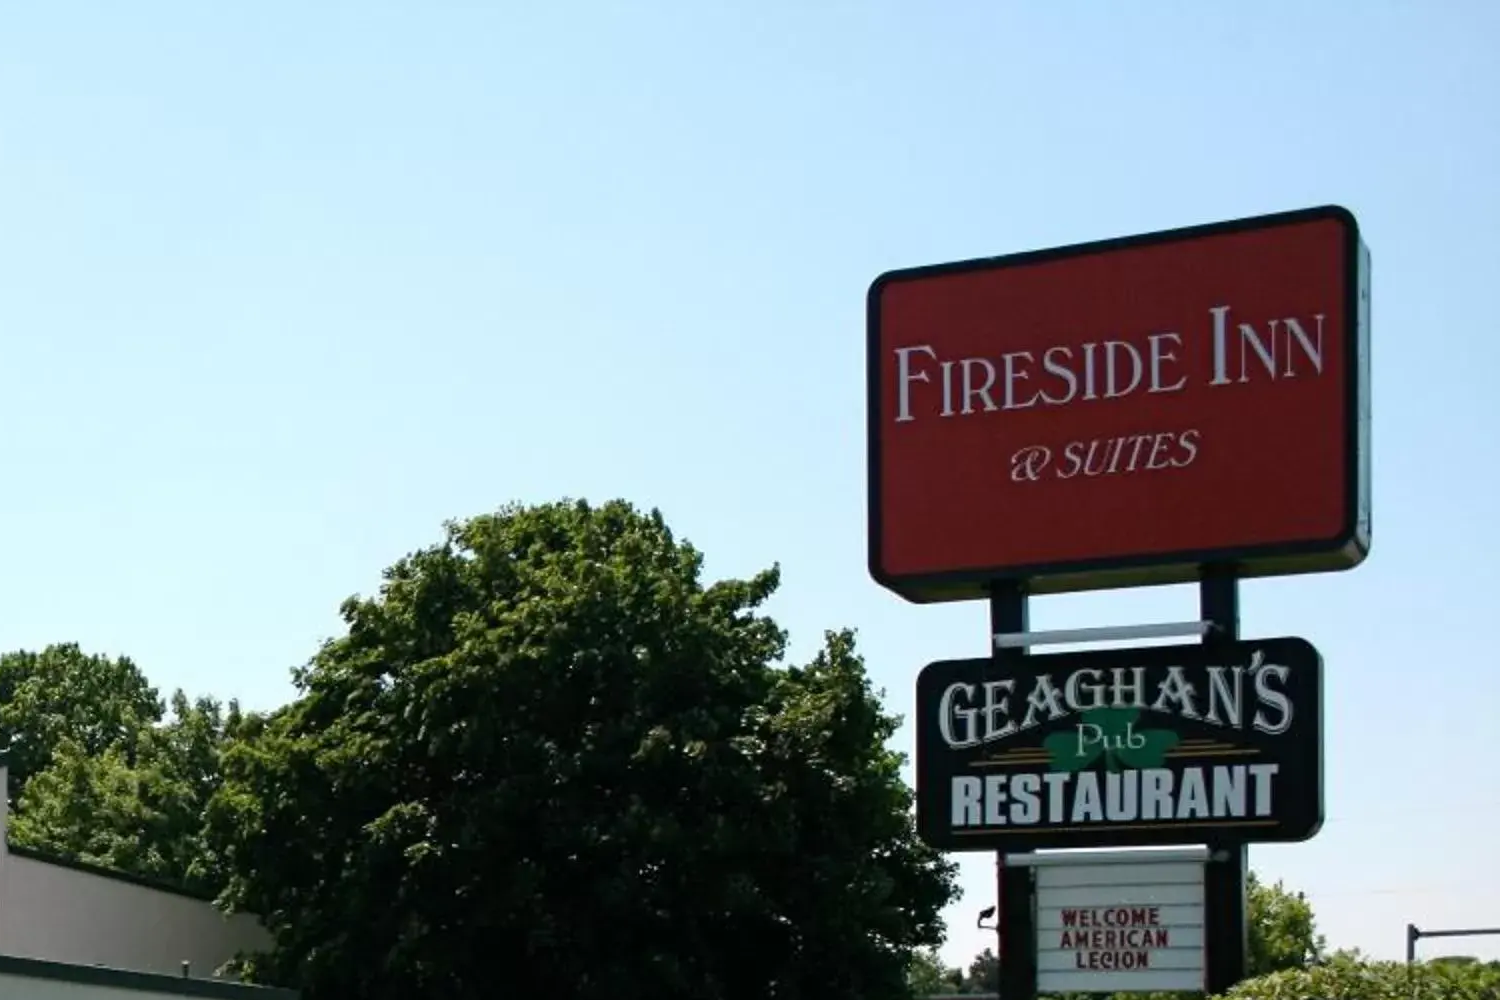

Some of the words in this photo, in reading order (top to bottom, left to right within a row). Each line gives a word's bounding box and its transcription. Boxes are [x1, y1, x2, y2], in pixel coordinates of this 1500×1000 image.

[893, 332, 1187, 422] FIRESIDE
[1209, 305, 1326, 386] INN
[1056, 429, 1200, 479] SUITES
[938, 650, 1295, 750] GEAGHAN'S
[1075, 722, 1146, 757] Pub
[951, 764, 1280, 826] RESTAURANT
[1060, 929, 1169, 949] AMERICAN
[1061, 907, 1160, 927] WELCOME
